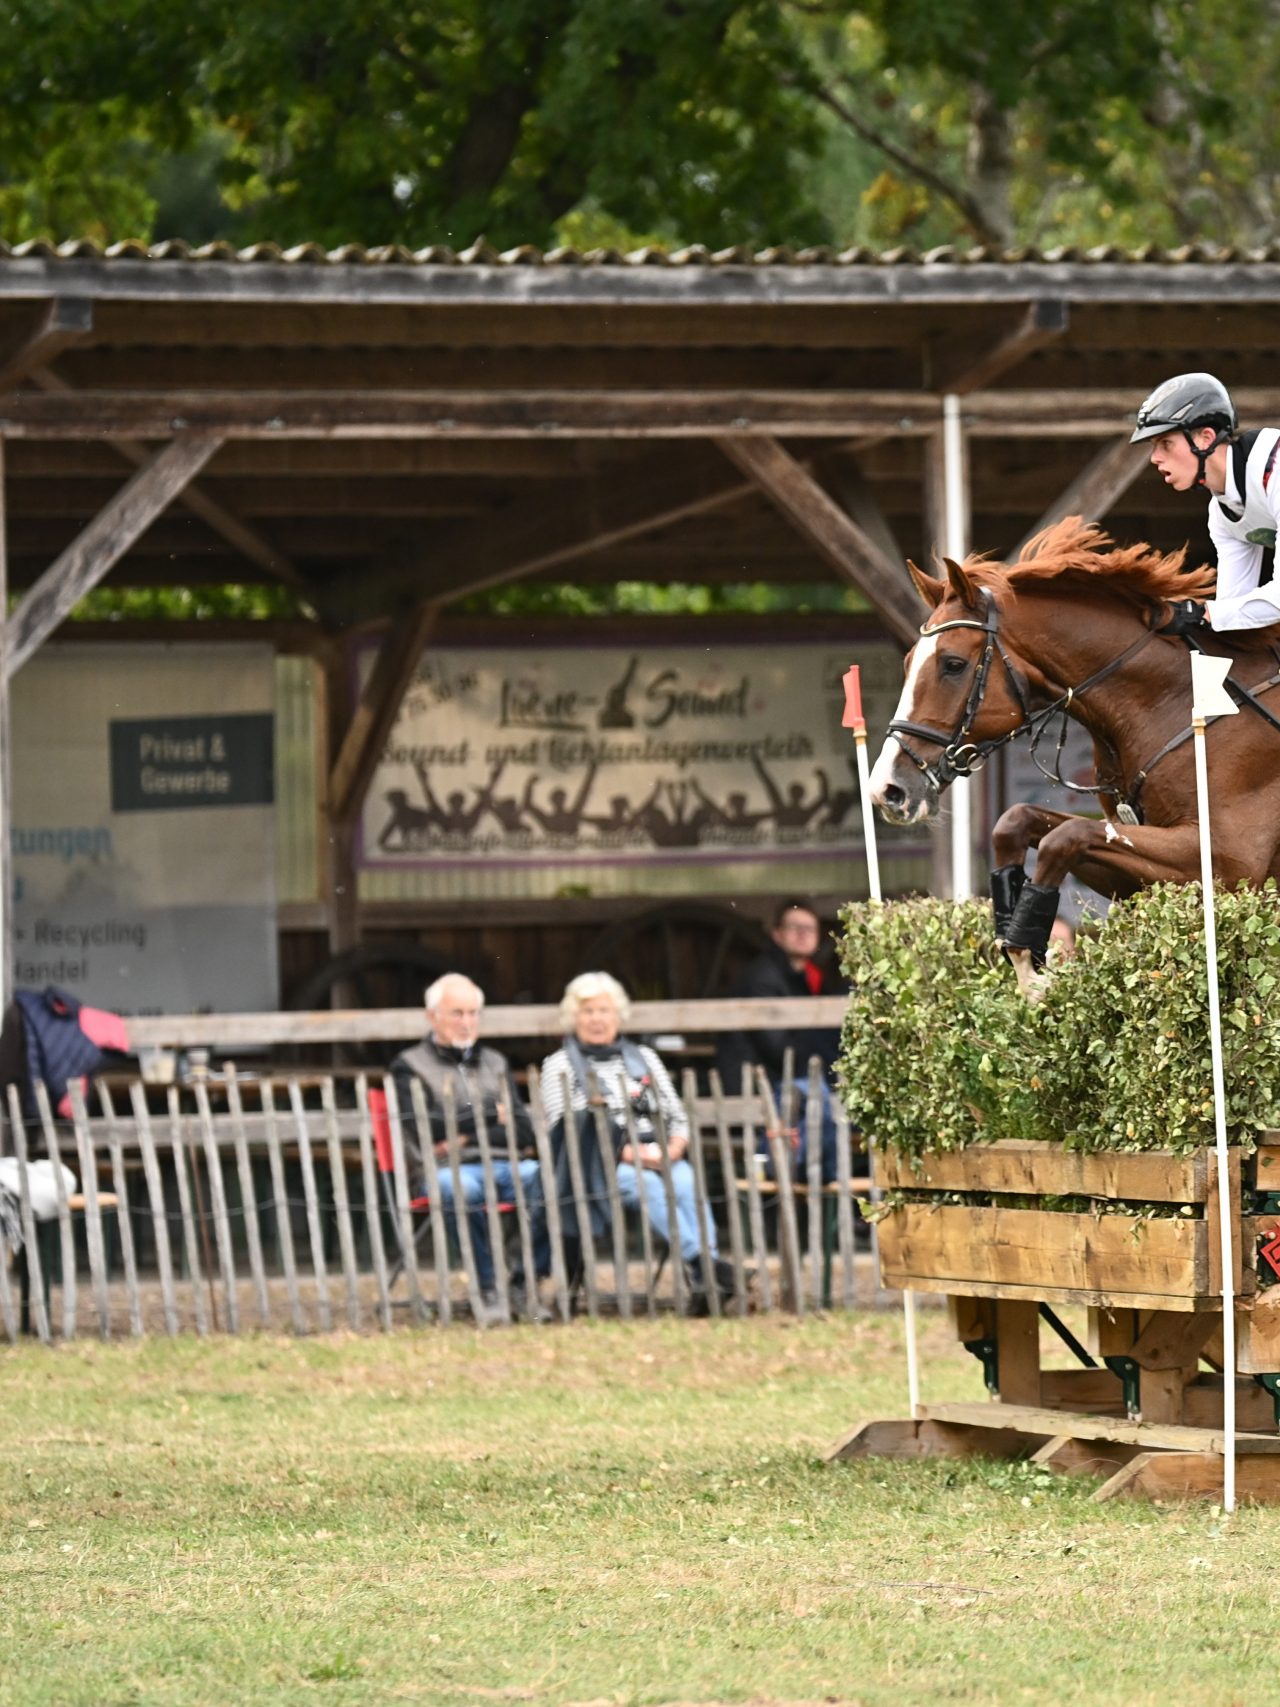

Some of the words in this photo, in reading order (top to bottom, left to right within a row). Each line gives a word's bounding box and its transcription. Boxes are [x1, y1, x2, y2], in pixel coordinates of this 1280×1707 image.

[139, 734, 204, 763] Privat
[210, 732, 227, 761] &
[485, 739, 539, 767] und
[140, 765, 232, 795] Gewerbe
[33, 917, 147, 951] Recycling
